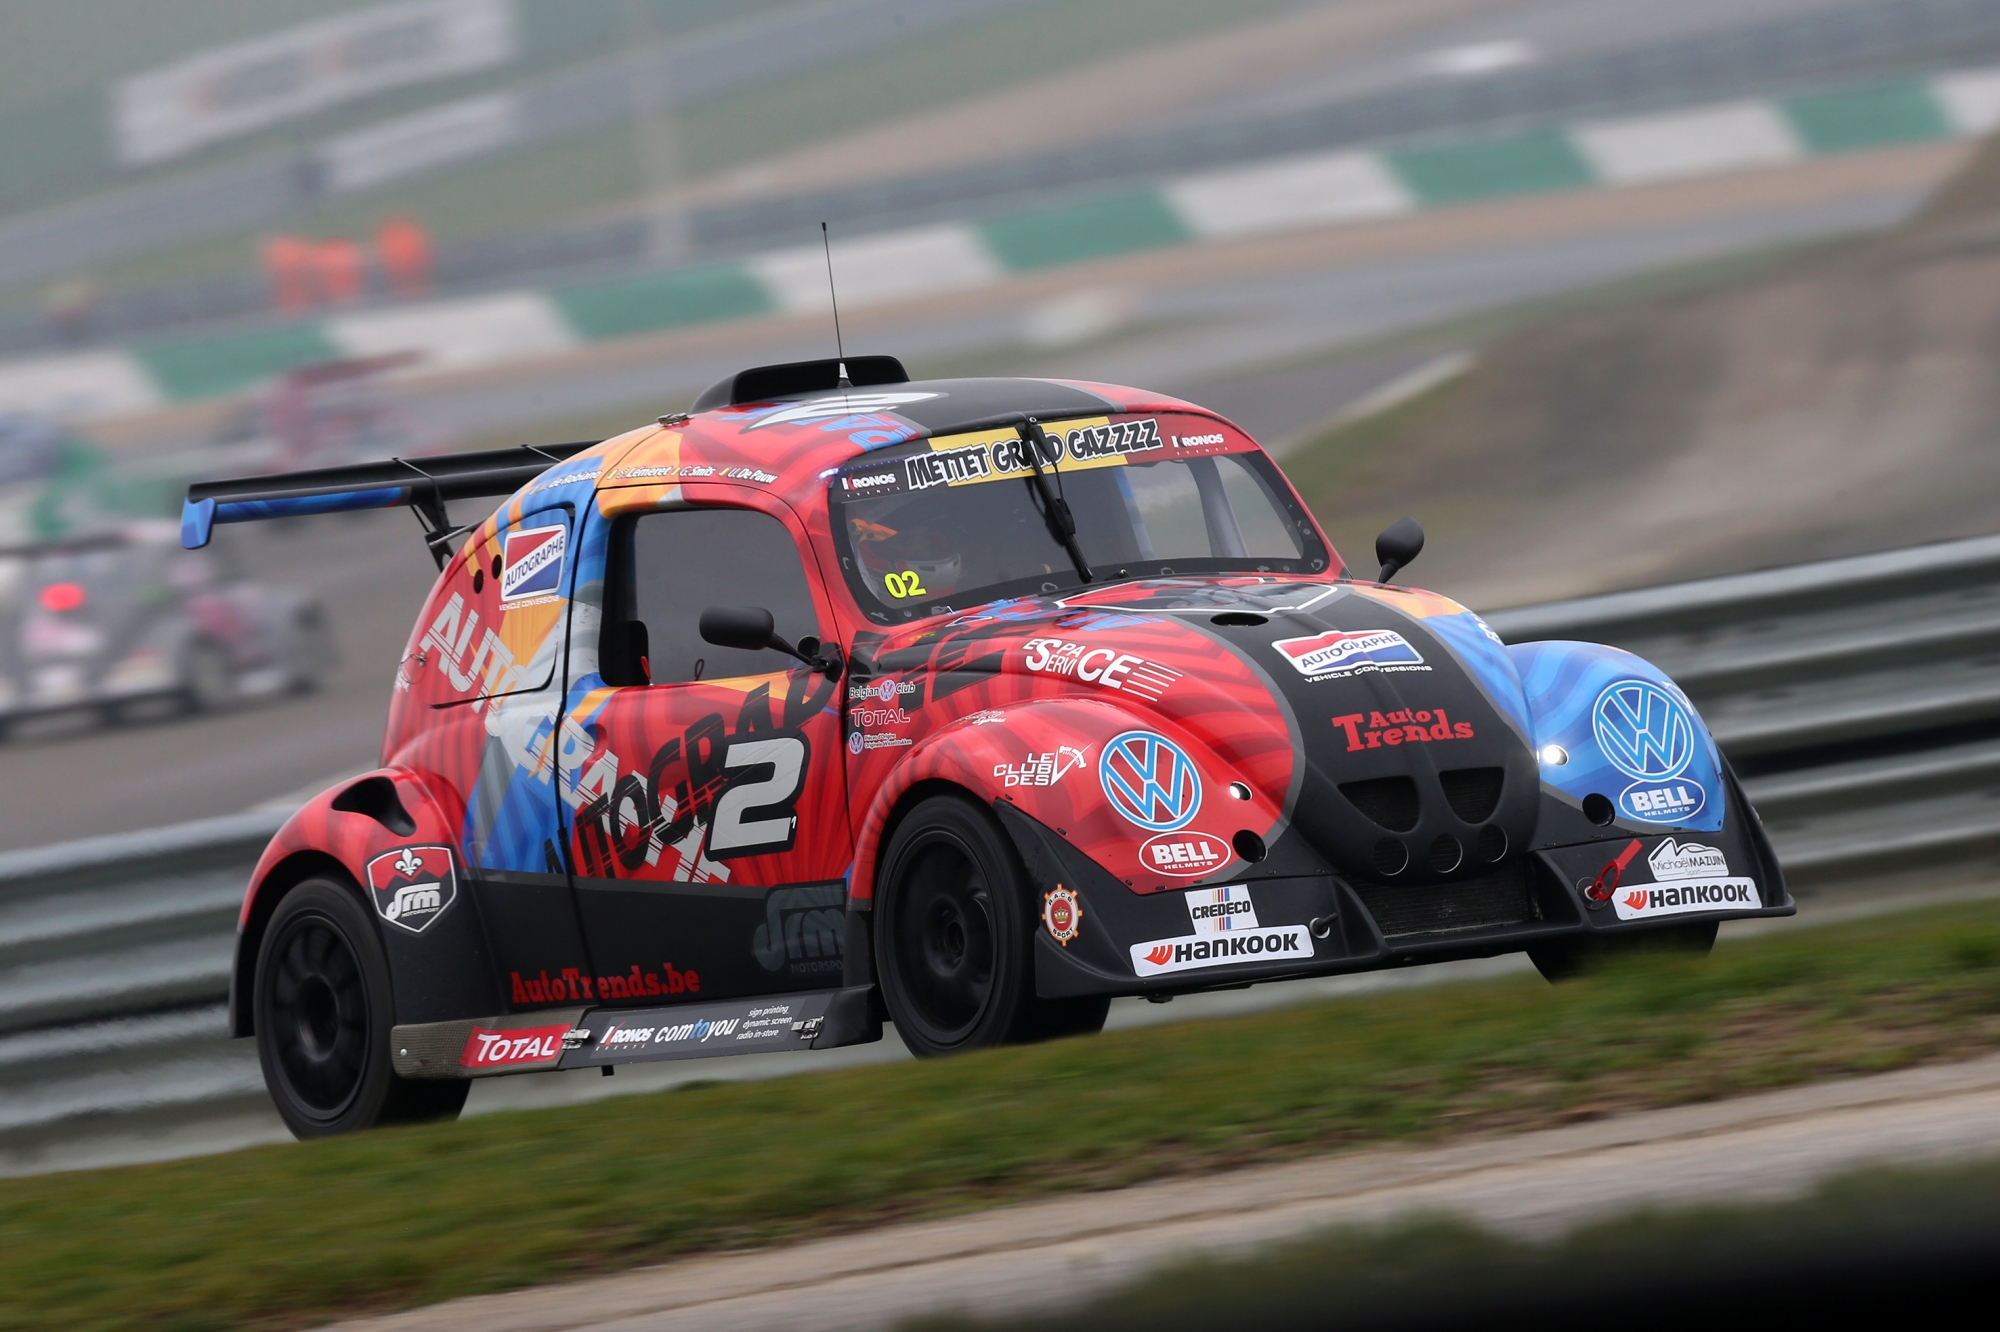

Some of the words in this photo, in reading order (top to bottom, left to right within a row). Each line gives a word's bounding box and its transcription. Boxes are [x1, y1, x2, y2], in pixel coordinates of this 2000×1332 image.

[1171, 432, 1224, 449] KRONOS
[904, 444, 992, 490] METTET
[991, 431, 1066, 475] GRND
[1066, 418, 1163, 461] GAZZZZ
[689, 465, 716, 477] Smits
[841, 473, 897, 491] KRONOS
[504, 535, 564, 590] AUTOGRAPHE
[884, 570, 927, 599] 02
[499, 601, 521, 611] VEHICLE
[1301, 633, 1402, 669] AUTOGRAPHE
[1304, 670, 1353, 684] VEHICLE
[1353, 665, 1433, 676] CONVERSIONS
[848, 685, 880, 700] Belgian
[895, 682, 916, 695] Club
[851, 708, 911, 727] TOTAL
[1369, 707, 1431, 728] Auto
[1331, 709, 1475, 752] Trends
[1026, 752, 1055, 764] LE
[993, 763, 1052, 777] CLUB
[709, 737, 805, 851] 2
[1630, 786, 1696, 812] BELL
[1644, 806, 1691, 817] HELMETS
[1151, 841, 1219, 865] BELL
[1164, 860, 1214, 870] HELMETS
[1192, 900, 1251, 920] CREDECO
[1053, 927, 1073, 939] SPORT
[511, 963, 700, 1004] AutoTrends.be
[748, 1008, 763, 1018] sign
[762, 1005, 789, 1016] printing
[742, 1018, 770, 1029] dynamic
[770, 1017, 793, 1026] screen
[600, 1022, 654, 1046] KRONOS
[736, 1030, 754, 1040] radio
[754, 1029, 779, 1038] in-store
[477, 1033, 556, 1062] TOTAL
